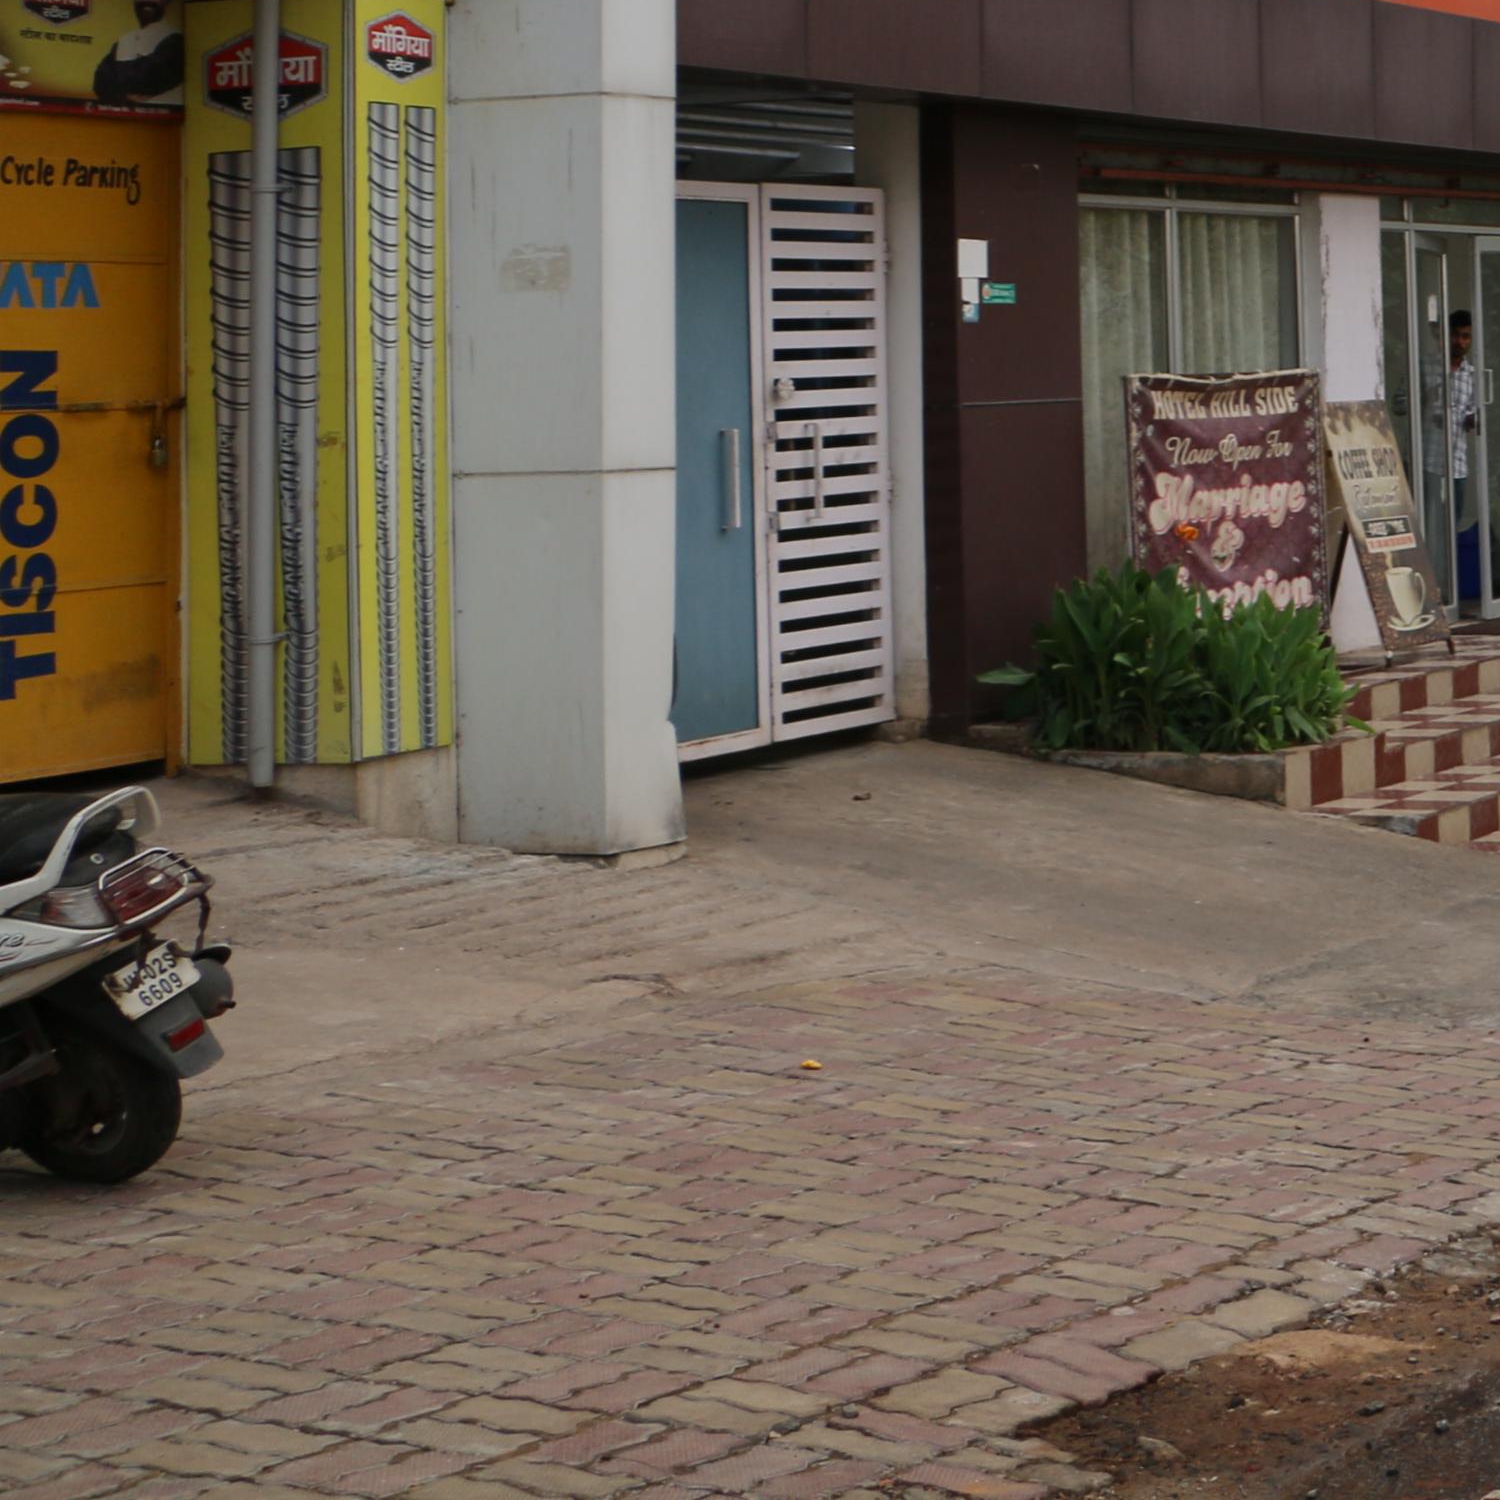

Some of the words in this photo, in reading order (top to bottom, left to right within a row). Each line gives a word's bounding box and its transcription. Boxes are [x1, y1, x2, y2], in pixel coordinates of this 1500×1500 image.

[0, 155, 55, 186] Cycle
[62, 158, 142, 206] Parking
[0, 260, 100, 309] ATA
[1151, 387, 1207, 420] HOTEL
[1210, 388, 1251, 418] HILL
[1255, 386, 1299, 415] SIDE
[1166, 436, 1217, 468] Now
[1218, 433, 1263, 471] Open
[1265, 429, 1294, 459] For
[0, 349, 60, 700] TISCON
[1150, 472, 1308, 535] Marriage
[1211, 520, 1245, 572] &
[139, 972, 182, 1006] 6609
